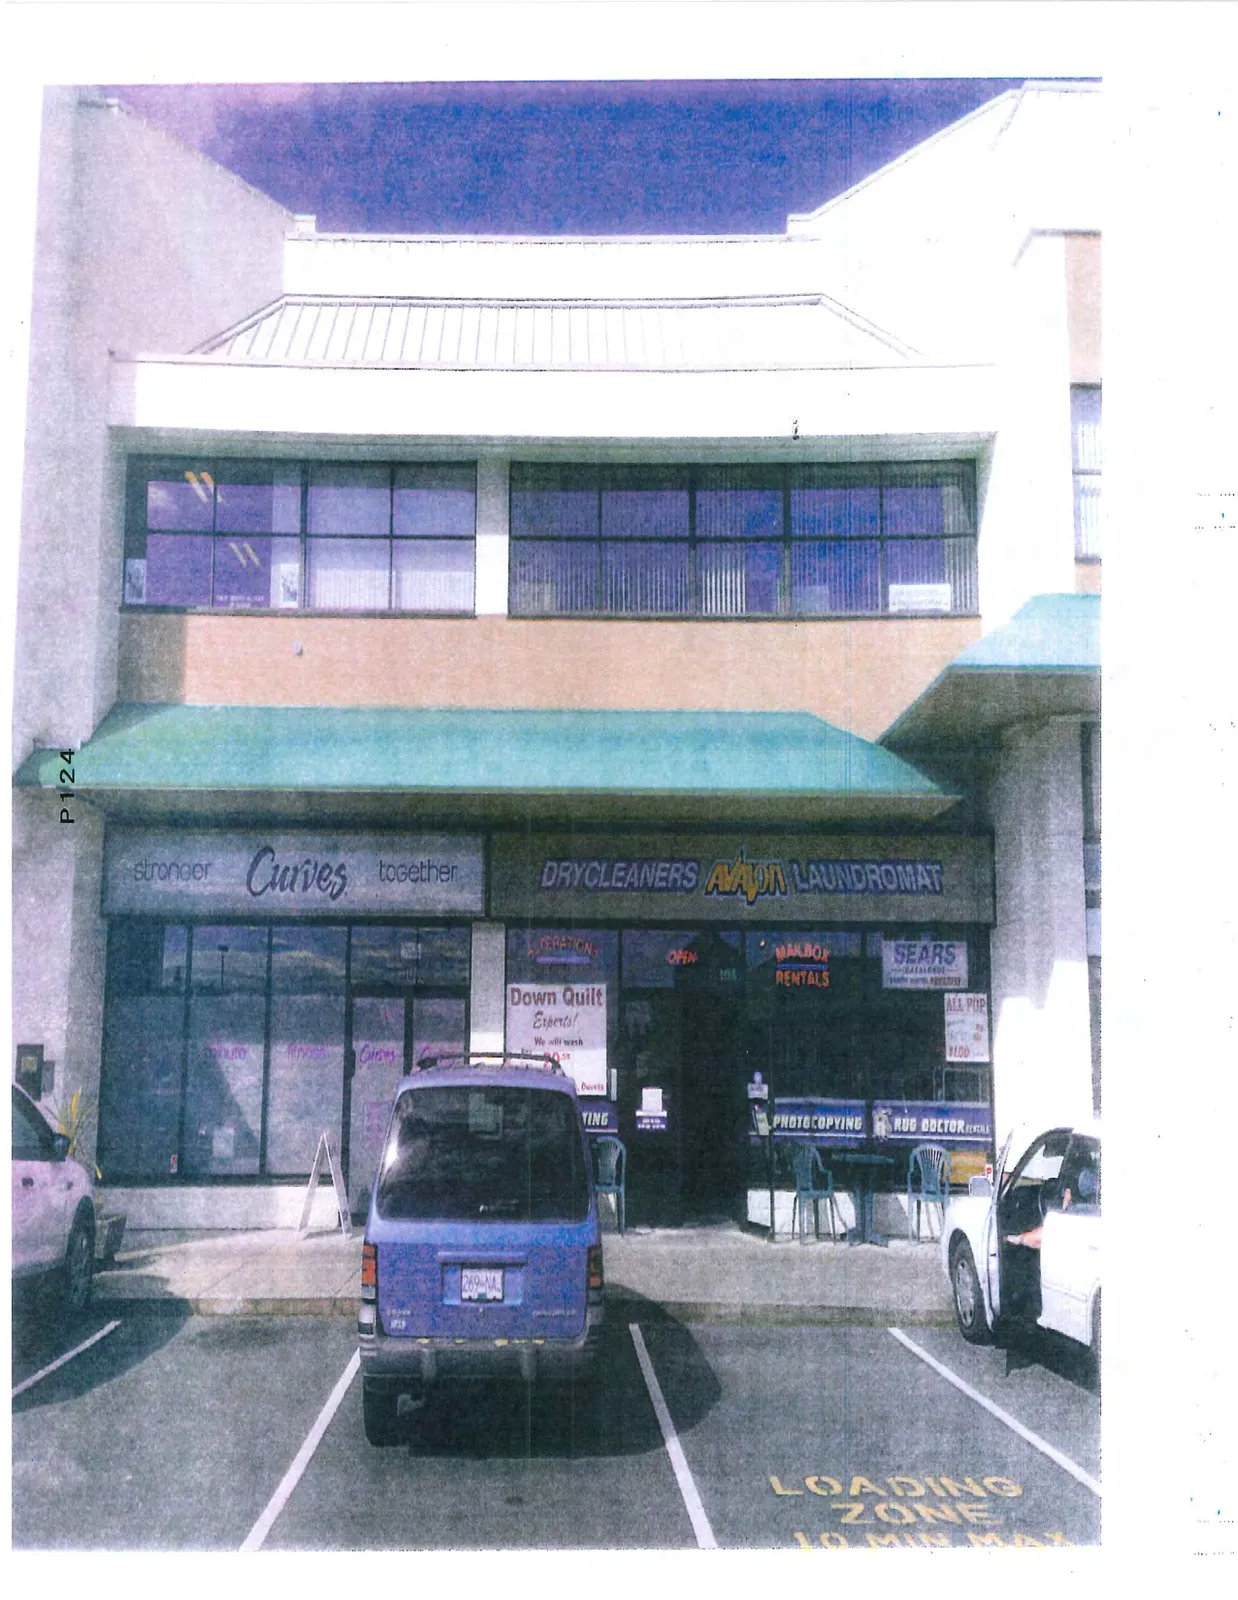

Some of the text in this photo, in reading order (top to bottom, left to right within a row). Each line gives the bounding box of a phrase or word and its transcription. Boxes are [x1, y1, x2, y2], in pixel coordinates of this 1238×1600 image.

[132, 845, 458, 901] stronger Curves together
[540, 859, 699, 890] DRYCLEANERS
[793, 859, 943, 893] LAUNDROMAT
[667, 950, 697, 965] OPEN
[893, 943, 957, 965] SEARS
[775, 970, 830, 988] RENTALS
[510, 985, 604, 1007] Down Quilt
[947, 997, 965, 1012] ALL
[532, 1010, 579, 1030] Experts!
[564, 1037, 584, 1046] wash
[773, 1114, 863, 1131] PHOTOCOPYING
[894, 1117, 917, 1133] RUG
[921, 1117, 965, 1134] DOCTOR
[769, 1475, 1023, 1498] LOADING
[831, 1502, 1001, 1525] ZONE
[794, 1531, 1073, 1550] 10 MIN MAX
